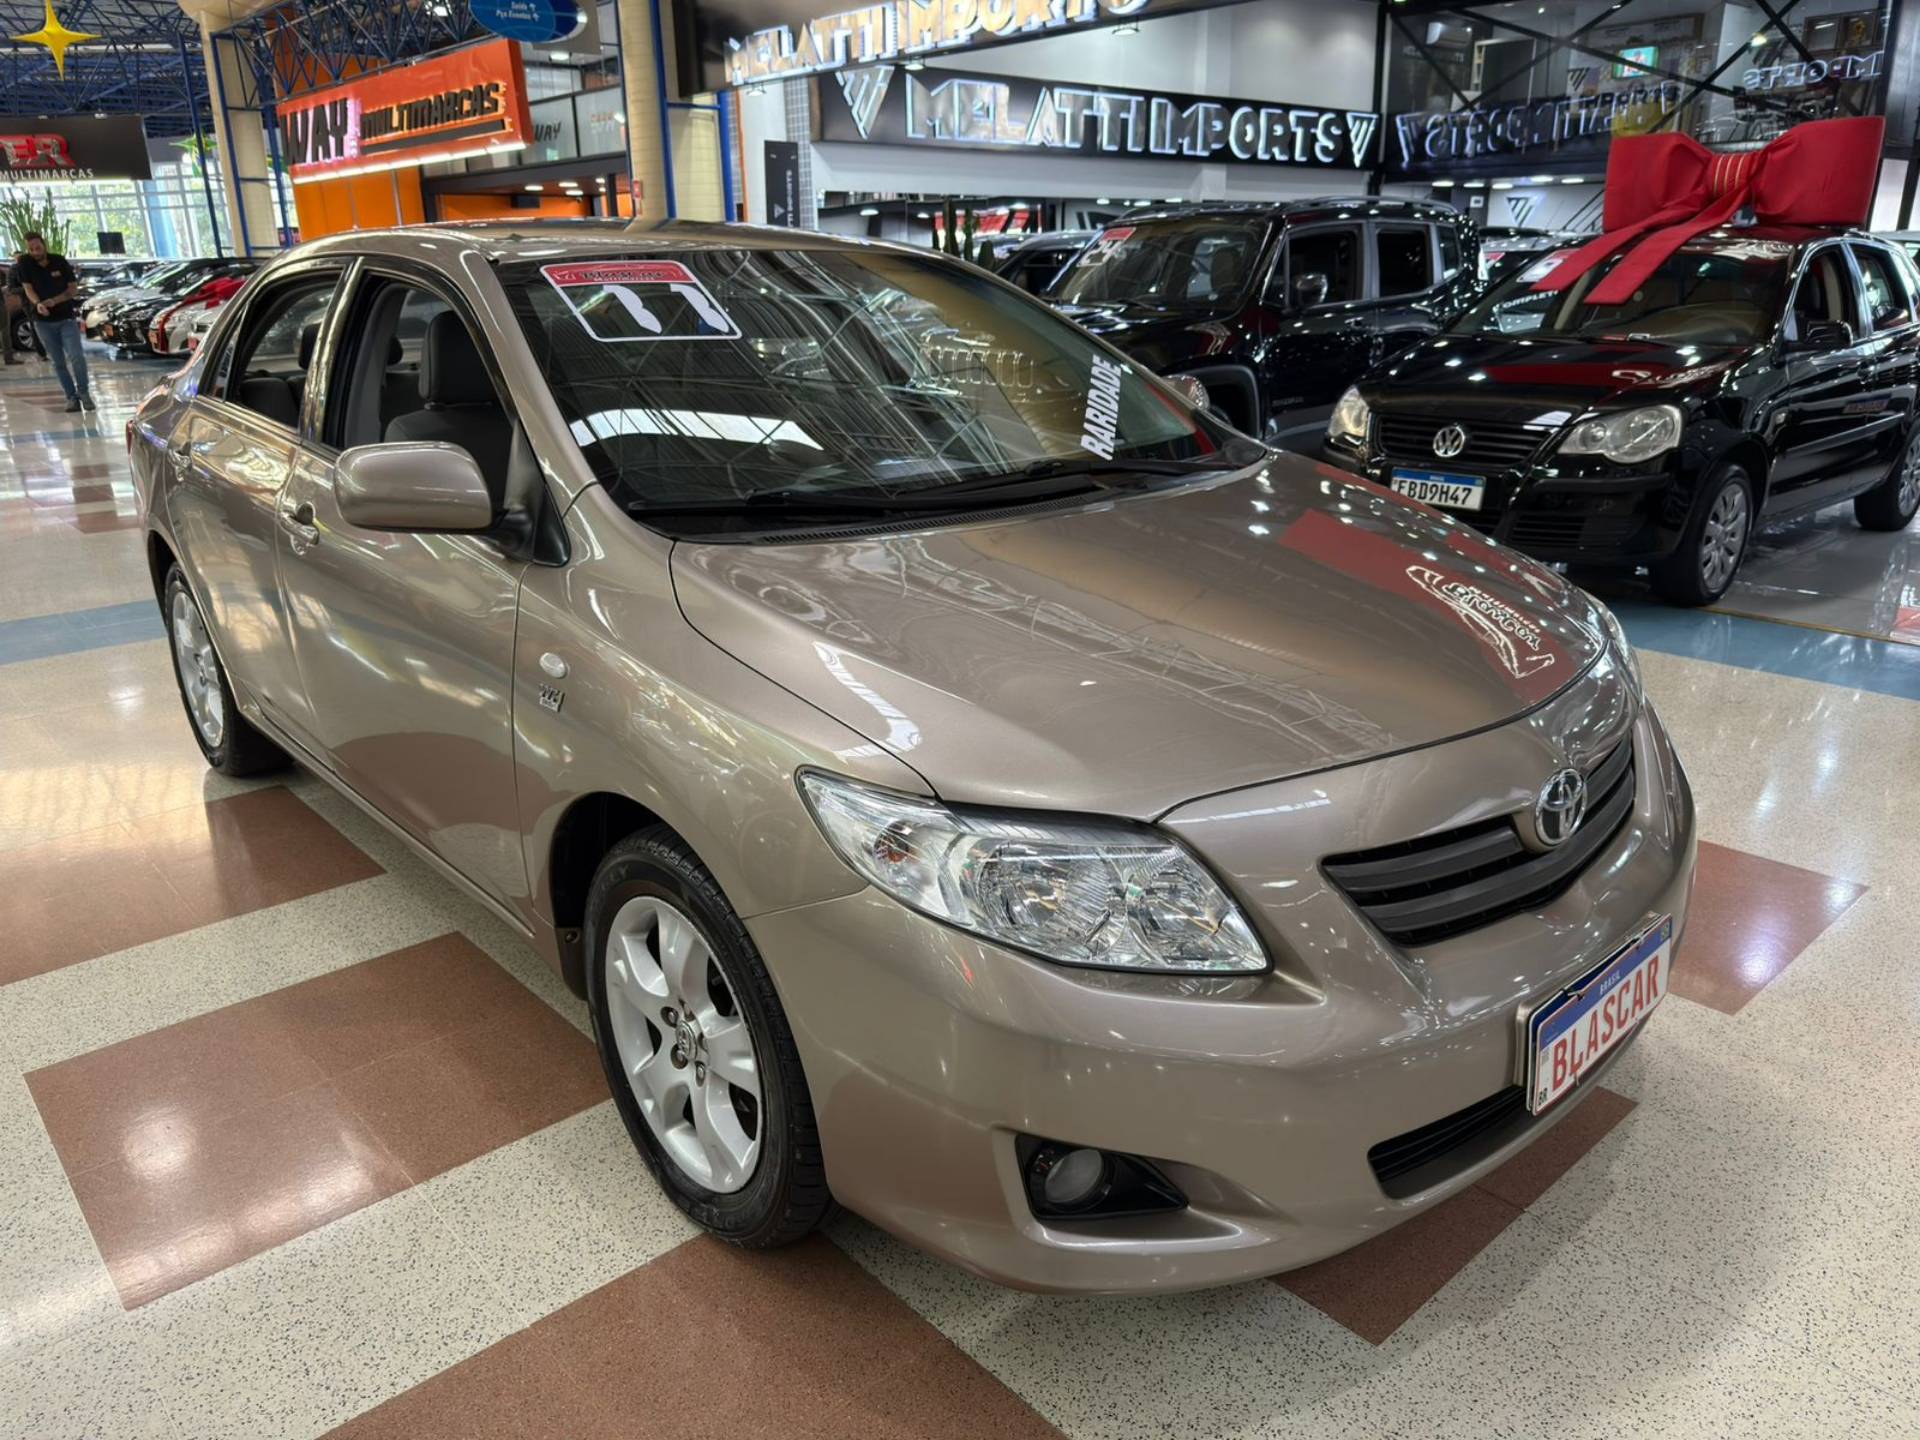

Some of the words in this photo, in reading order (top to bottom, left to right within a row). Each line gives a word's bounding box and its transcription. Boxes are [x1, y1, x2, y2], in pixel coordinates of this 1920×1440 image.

[280, 97, 349, 165] WAY
[361, 83, 501, 140] MULTIMARCAS
[905, 72, 1145, 153] MELATTI
[1150, 97, 1344, 163] IMPORTS
[0, 168, 94, 180] MULTIMARCAS
[1080, 353, 1121, 461] RARIDADE
[1552, 954, 1660, 1092] BLASCAR
